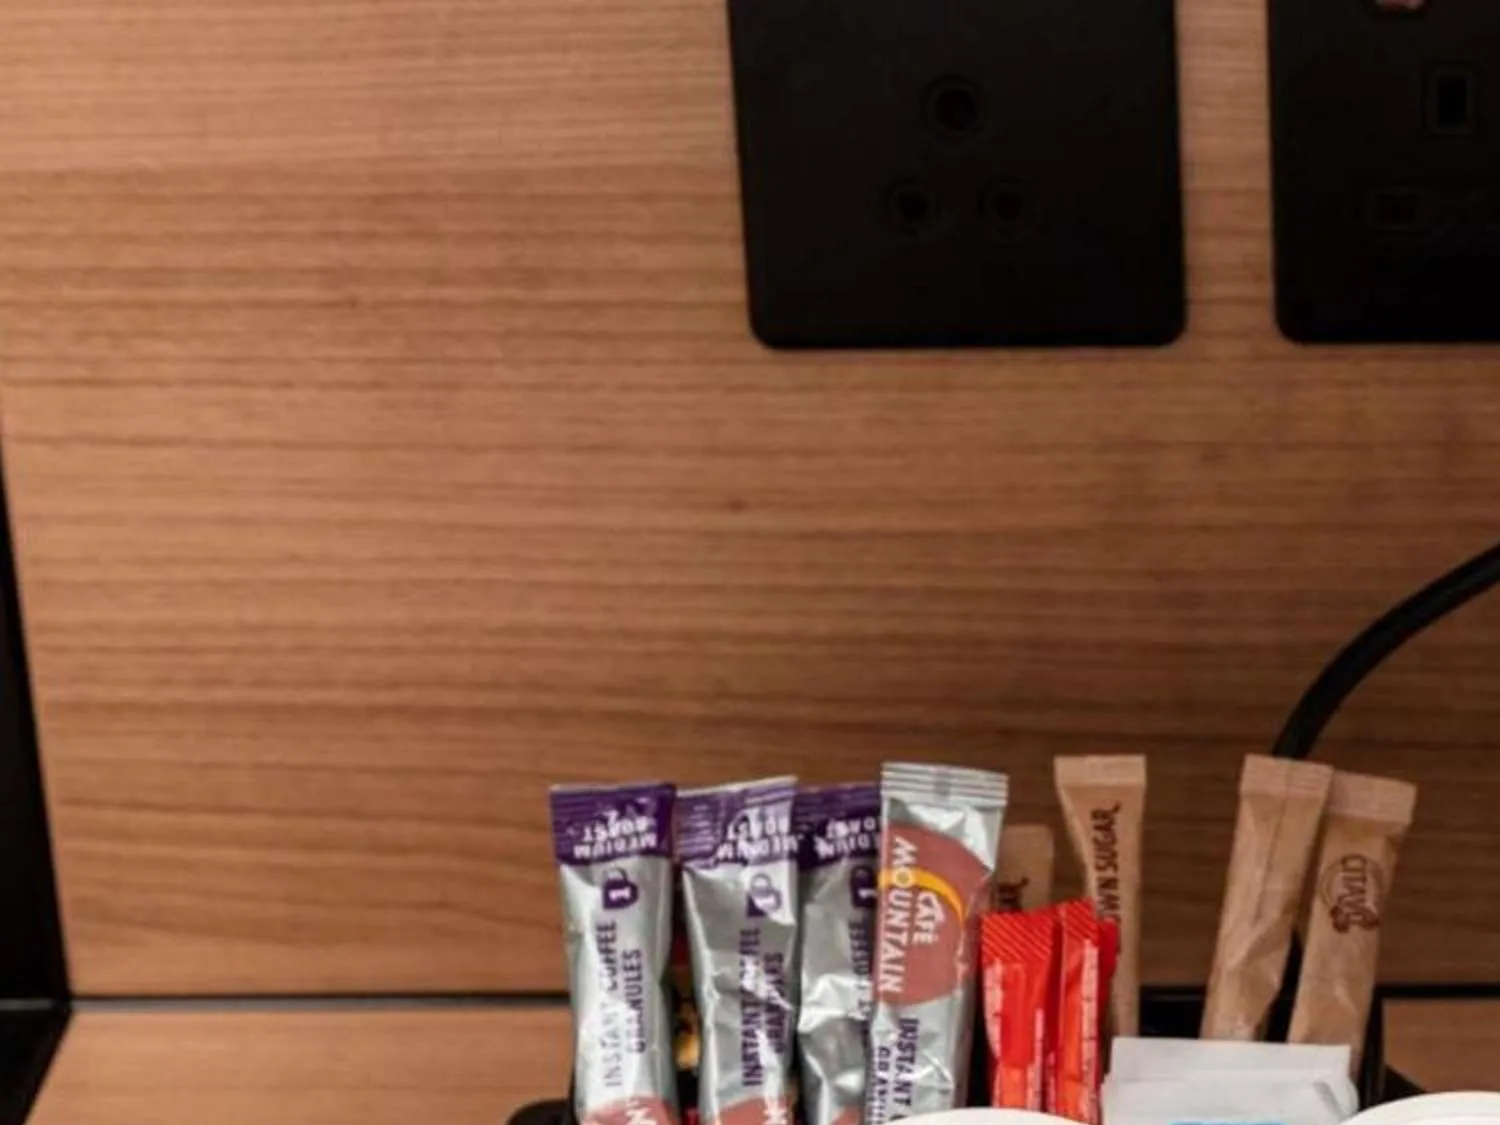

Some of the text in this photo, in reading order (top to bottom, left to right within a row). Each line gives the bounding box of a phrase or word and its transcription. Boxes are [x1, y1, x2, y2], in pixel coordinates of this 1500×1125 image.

[826, 817, 877, 839] OAST
[1090, 803, 1121, 872] SUGAR
[878, 836, 918, 992] MOUNTAIN
[600, 999, 623, 1087] INSTAN
[893, 1018, 918, 1106] INSTANT
